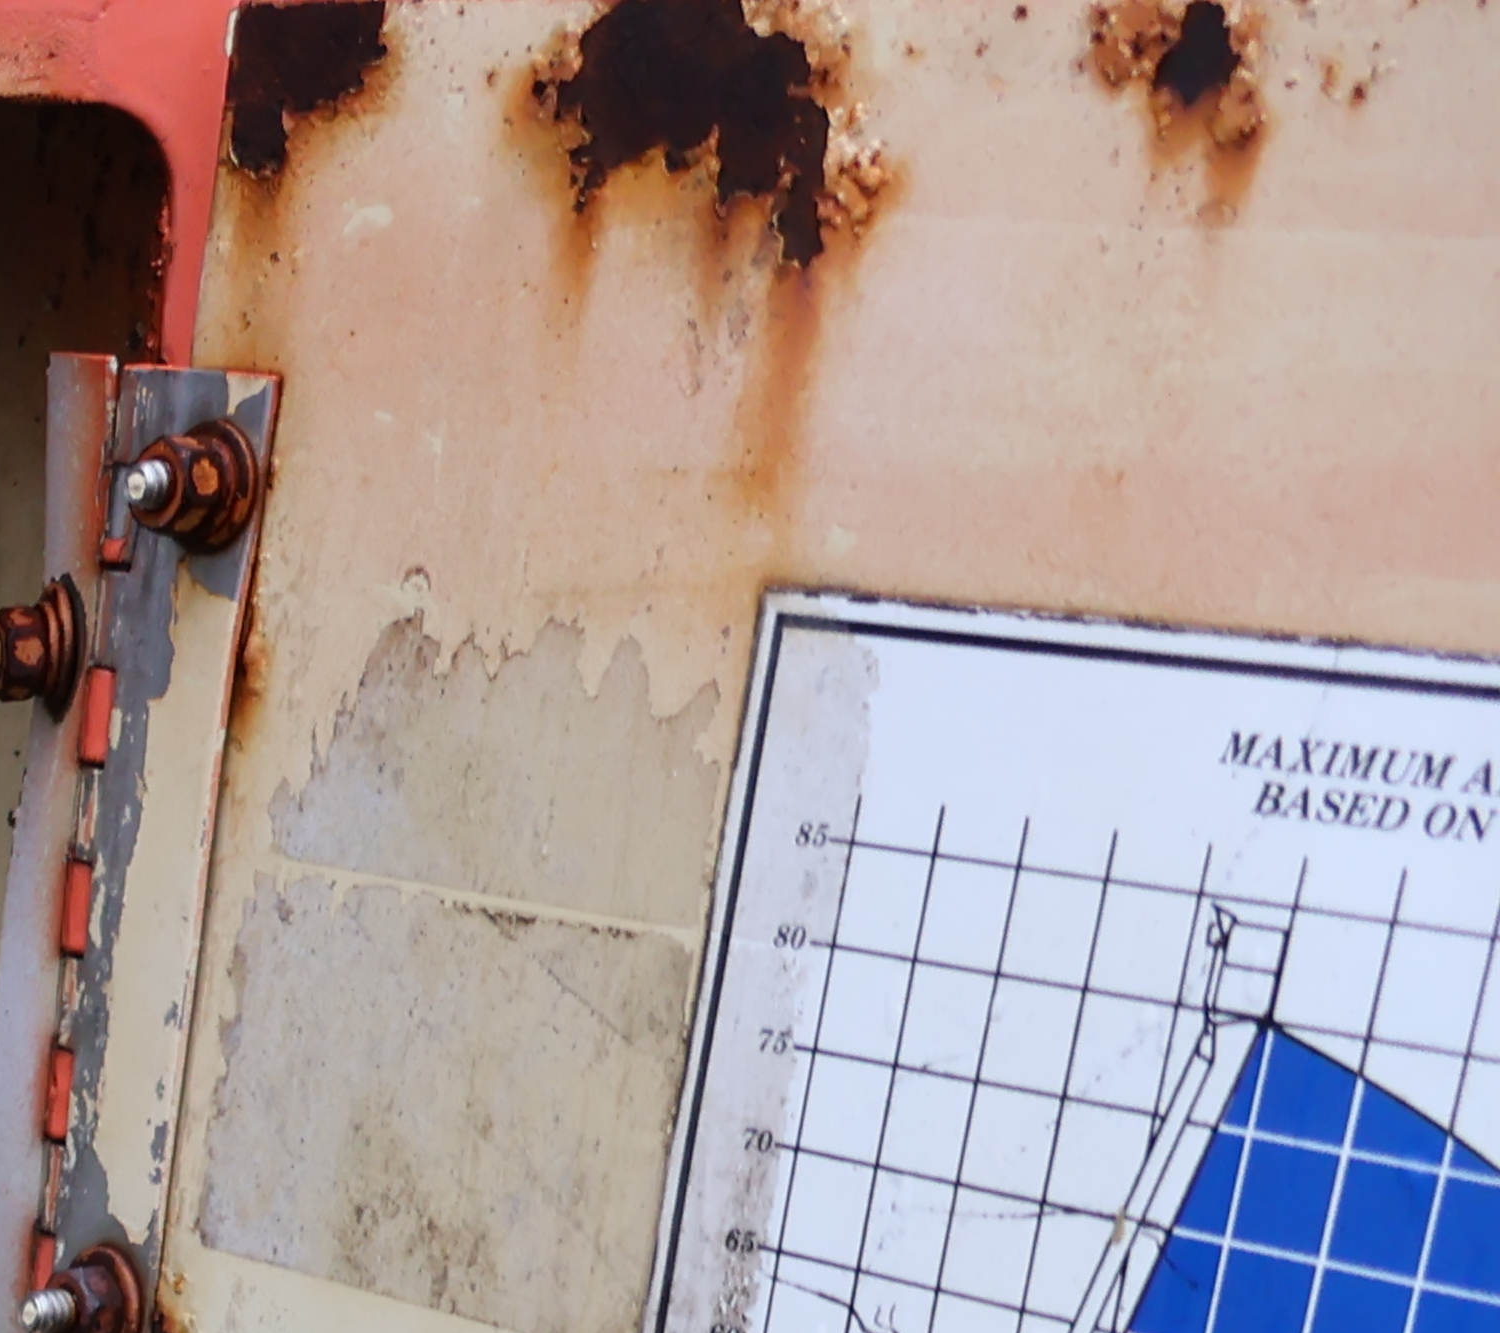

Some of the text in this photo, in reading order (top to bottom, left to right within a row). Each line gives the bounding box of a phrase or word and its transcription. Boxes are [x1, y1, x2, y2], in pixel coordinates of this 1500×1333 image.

[1218, 729, 1457, 791] MAXIMUM
[1251, 781, 1499, 844] BASED ON
[796, 823, 829, 849] 85
[774, 925, 807, 951] 80
